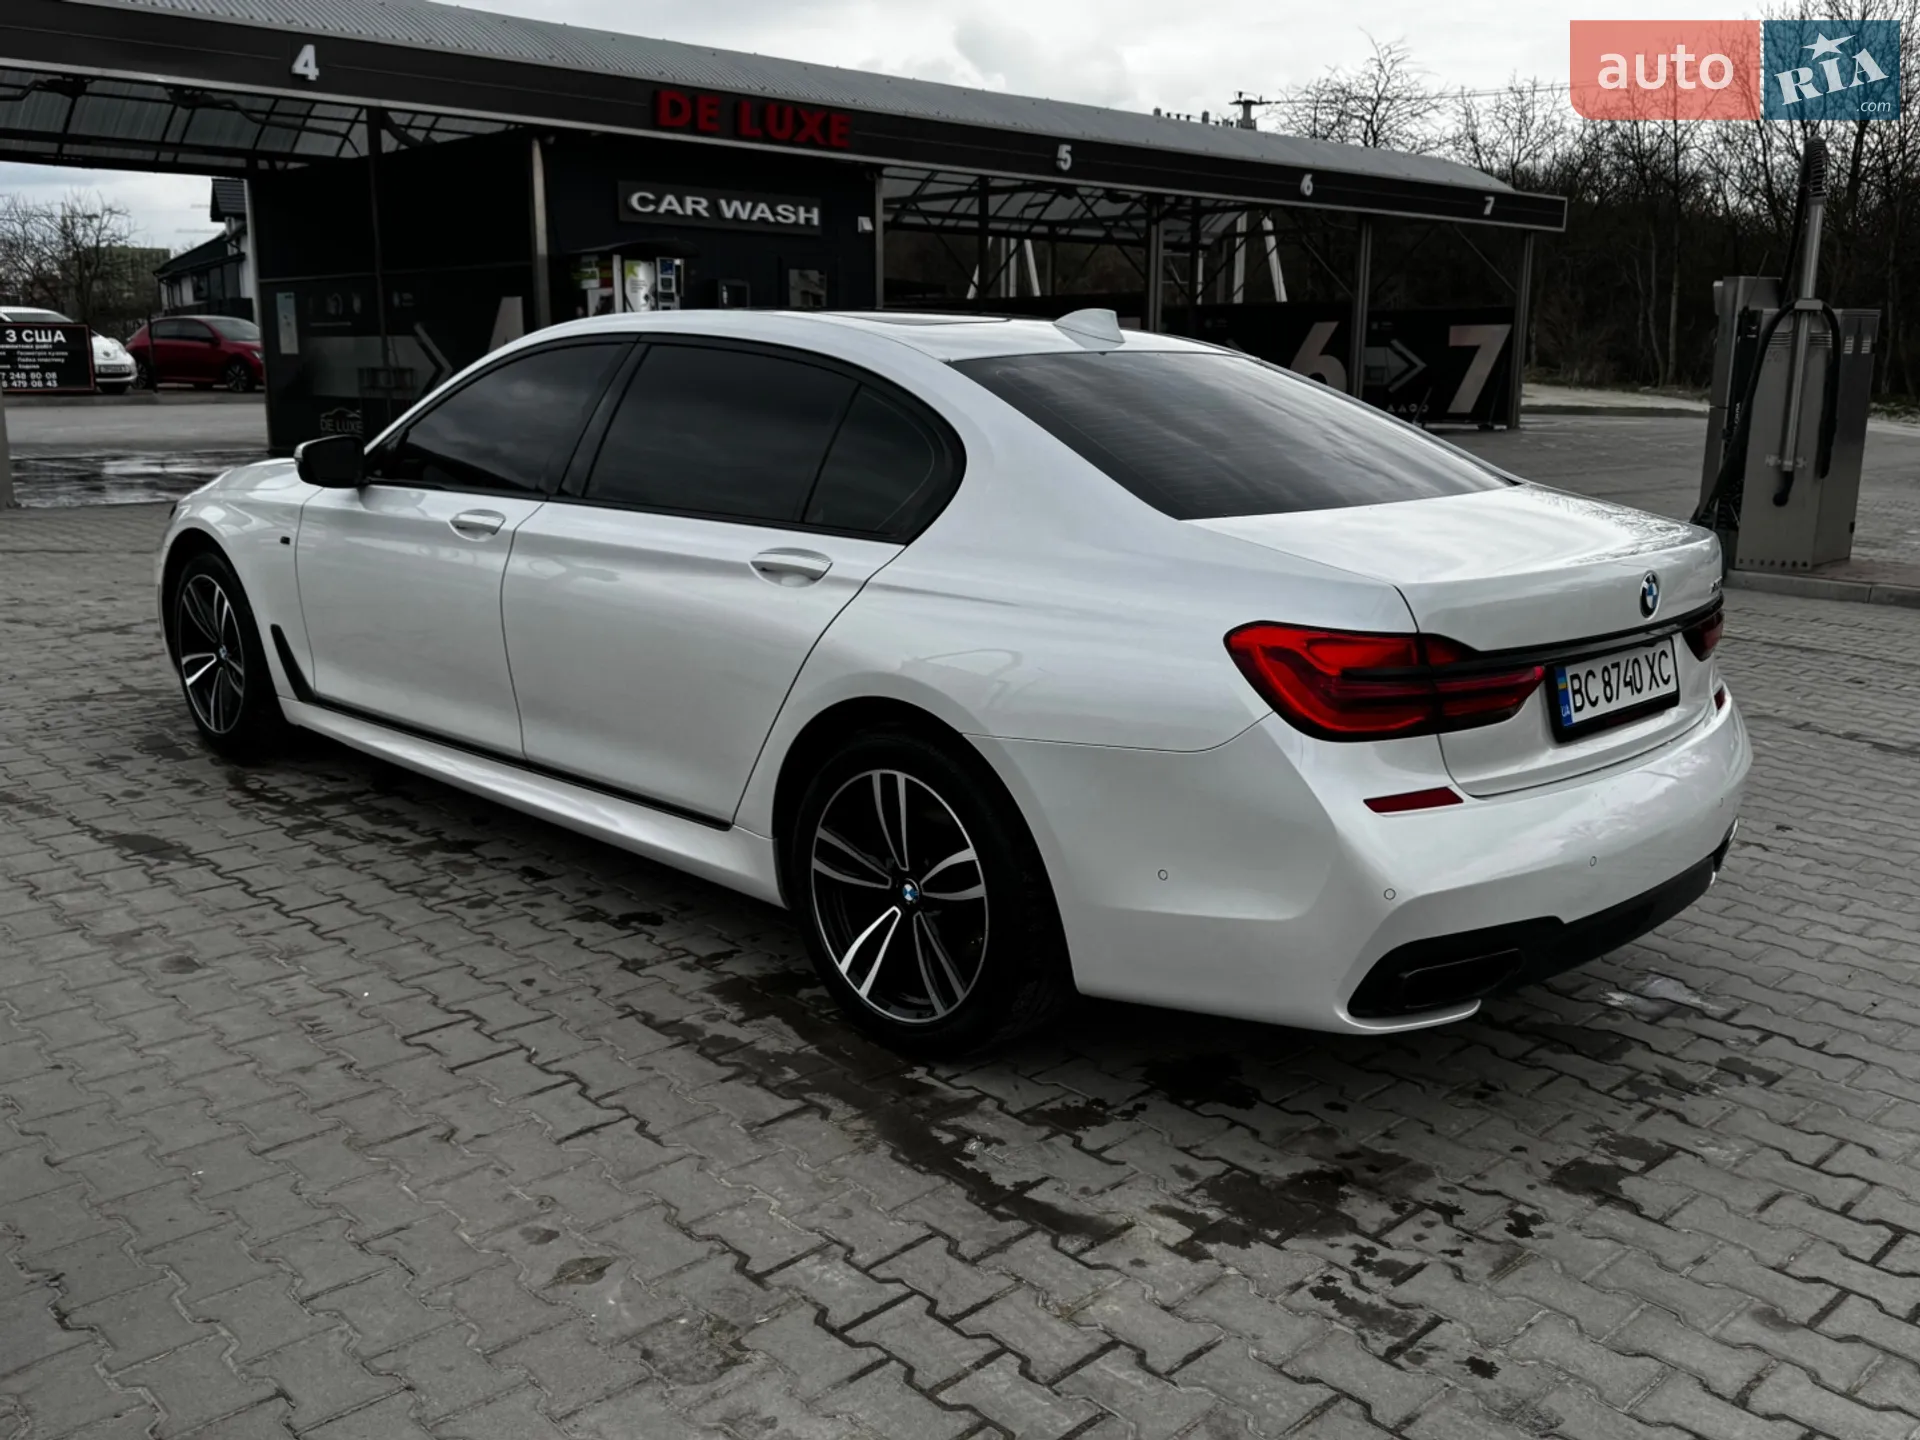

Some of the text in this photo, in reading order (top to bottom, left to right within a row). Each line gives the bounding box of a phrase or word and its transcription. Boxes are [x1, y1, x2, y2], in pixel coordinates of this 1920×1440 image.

[291, 44, 320, 81] 4
[657, 89, 853, 148] DE LUXE
[1056, 144, 1072, 171] 5
[1301, 174, 1314, 197] 6
[629, 191, 820, 226] CAR WASH
[1483, 196, 1495, 216] 7
[21, 329, 67, 343] США
[1290, 321, 1348, 395] 6
[1448, 324, 1512, 414] 7
[1568, 650, 1672, 713] BC 8740 XC
[1561, 705, 1571, 717] UA
